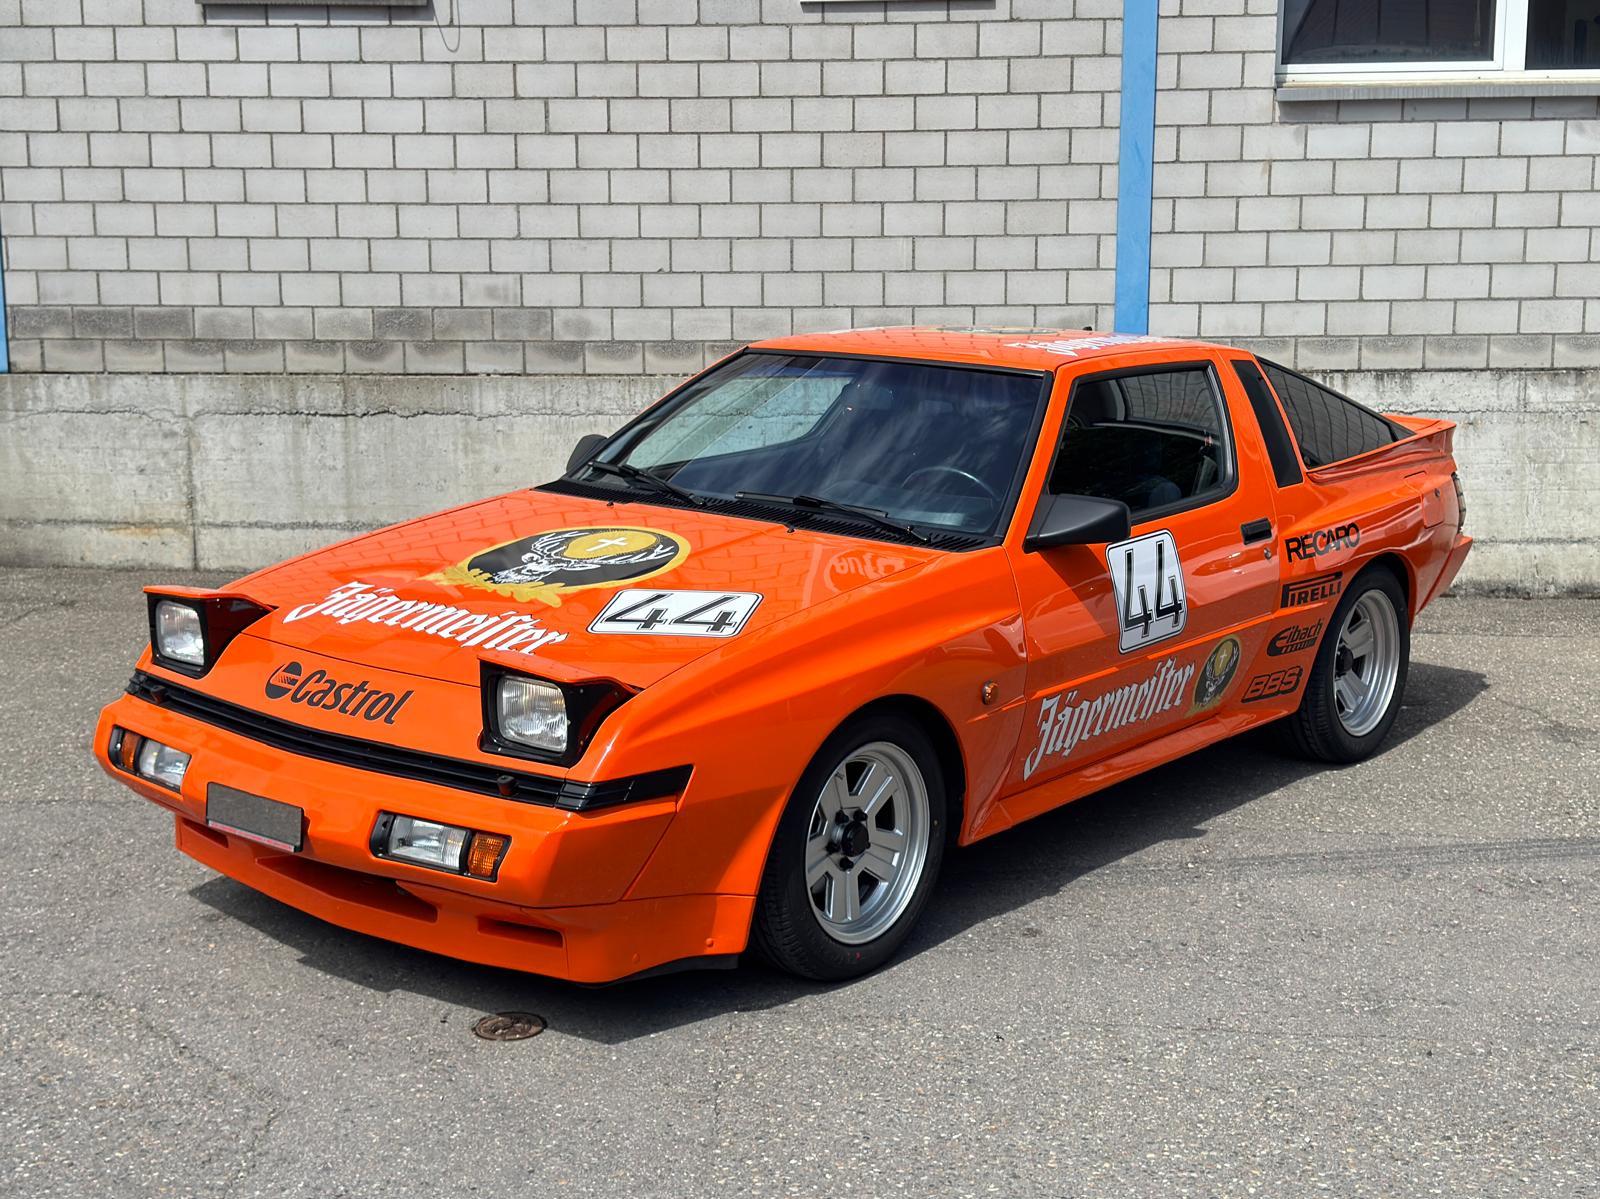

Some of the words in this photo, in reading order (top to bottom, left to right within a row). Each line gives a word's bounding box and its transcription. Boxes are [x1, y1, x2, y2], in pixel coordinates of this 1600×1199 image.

[1285, 522, 1360, 563] RECARO
[1123, 540, 1184, 639] 44
[1280, 571, 1343, 608] PIRELLI
[599, 593, 741, 633] 44
[1267, 618, 1323, 656] Eibach
[291, 669, 414, 725] Castrol
[1241, 665, 1303, 703] BBS
